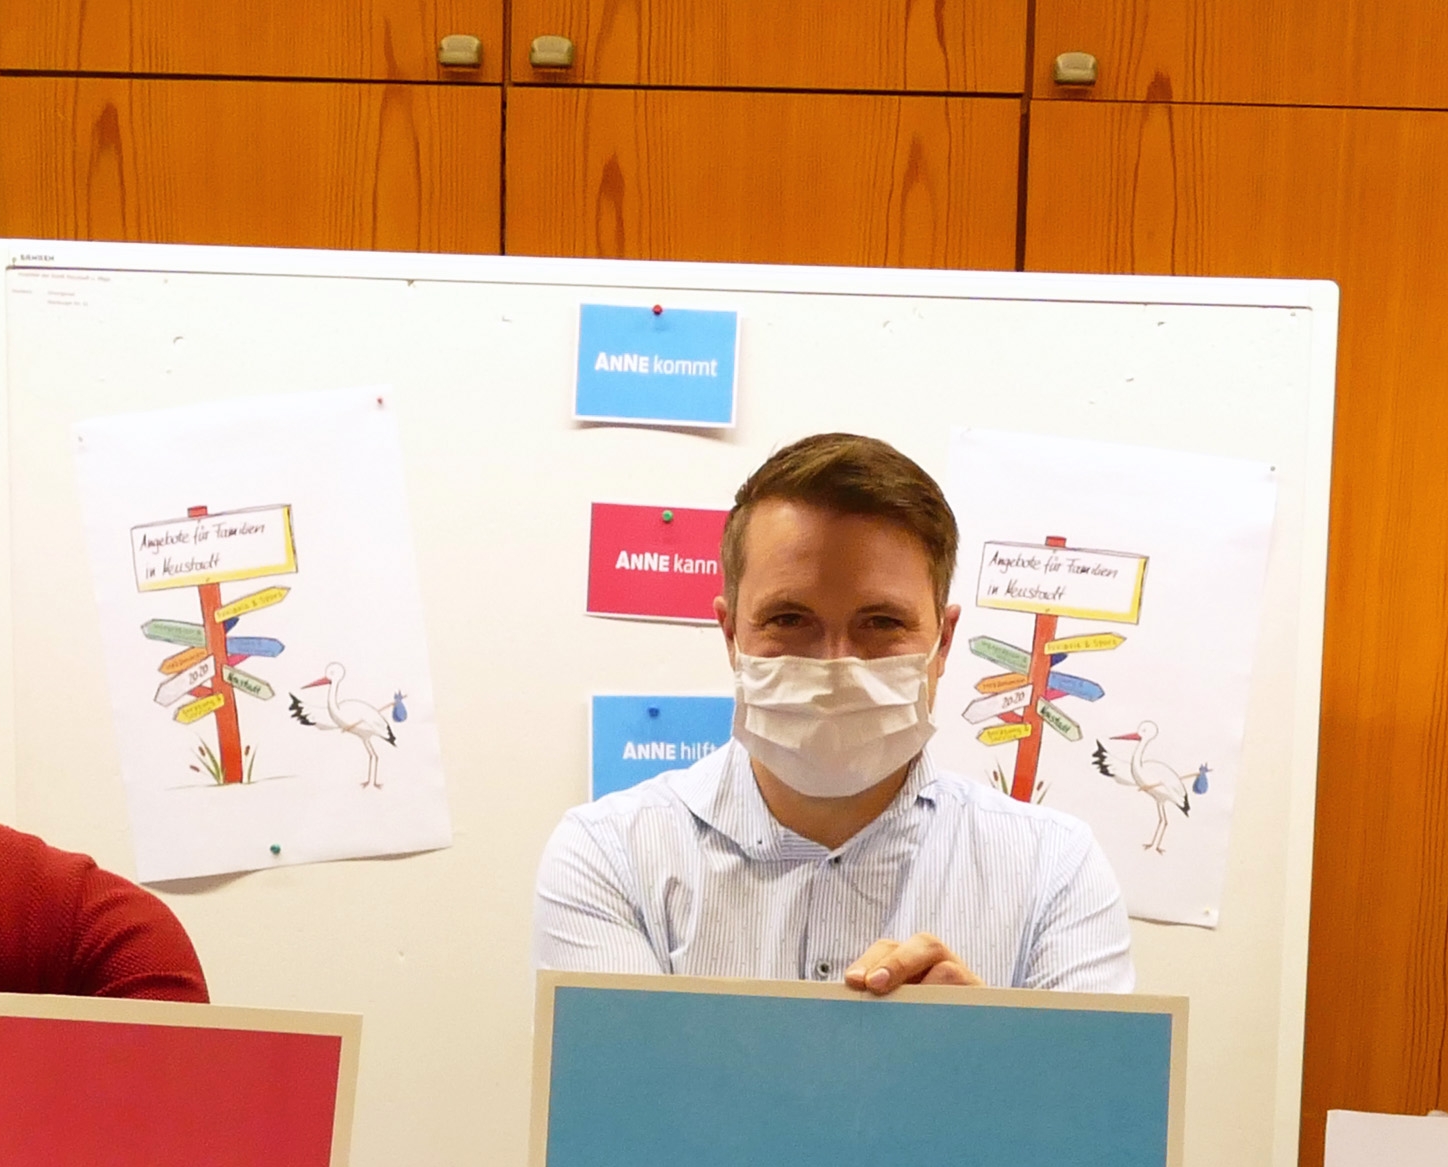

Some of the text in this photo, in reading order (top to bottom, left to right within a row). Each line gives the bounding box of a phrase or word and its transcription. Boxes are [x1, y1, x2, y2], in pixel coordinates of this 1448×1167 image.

[653, 354, 717, 377] kommt
[139, 530, 190, 554] Angebote
[193, 523, 209, 545] für
[145, 552, 220, 579] in Neustadt
[673, 553, 717, 575] kann
[989, 551, 1041, 574] Angebote
[1044, 555, 1062, 575] für
[987, 579, 1065, 600] in Neustadt
